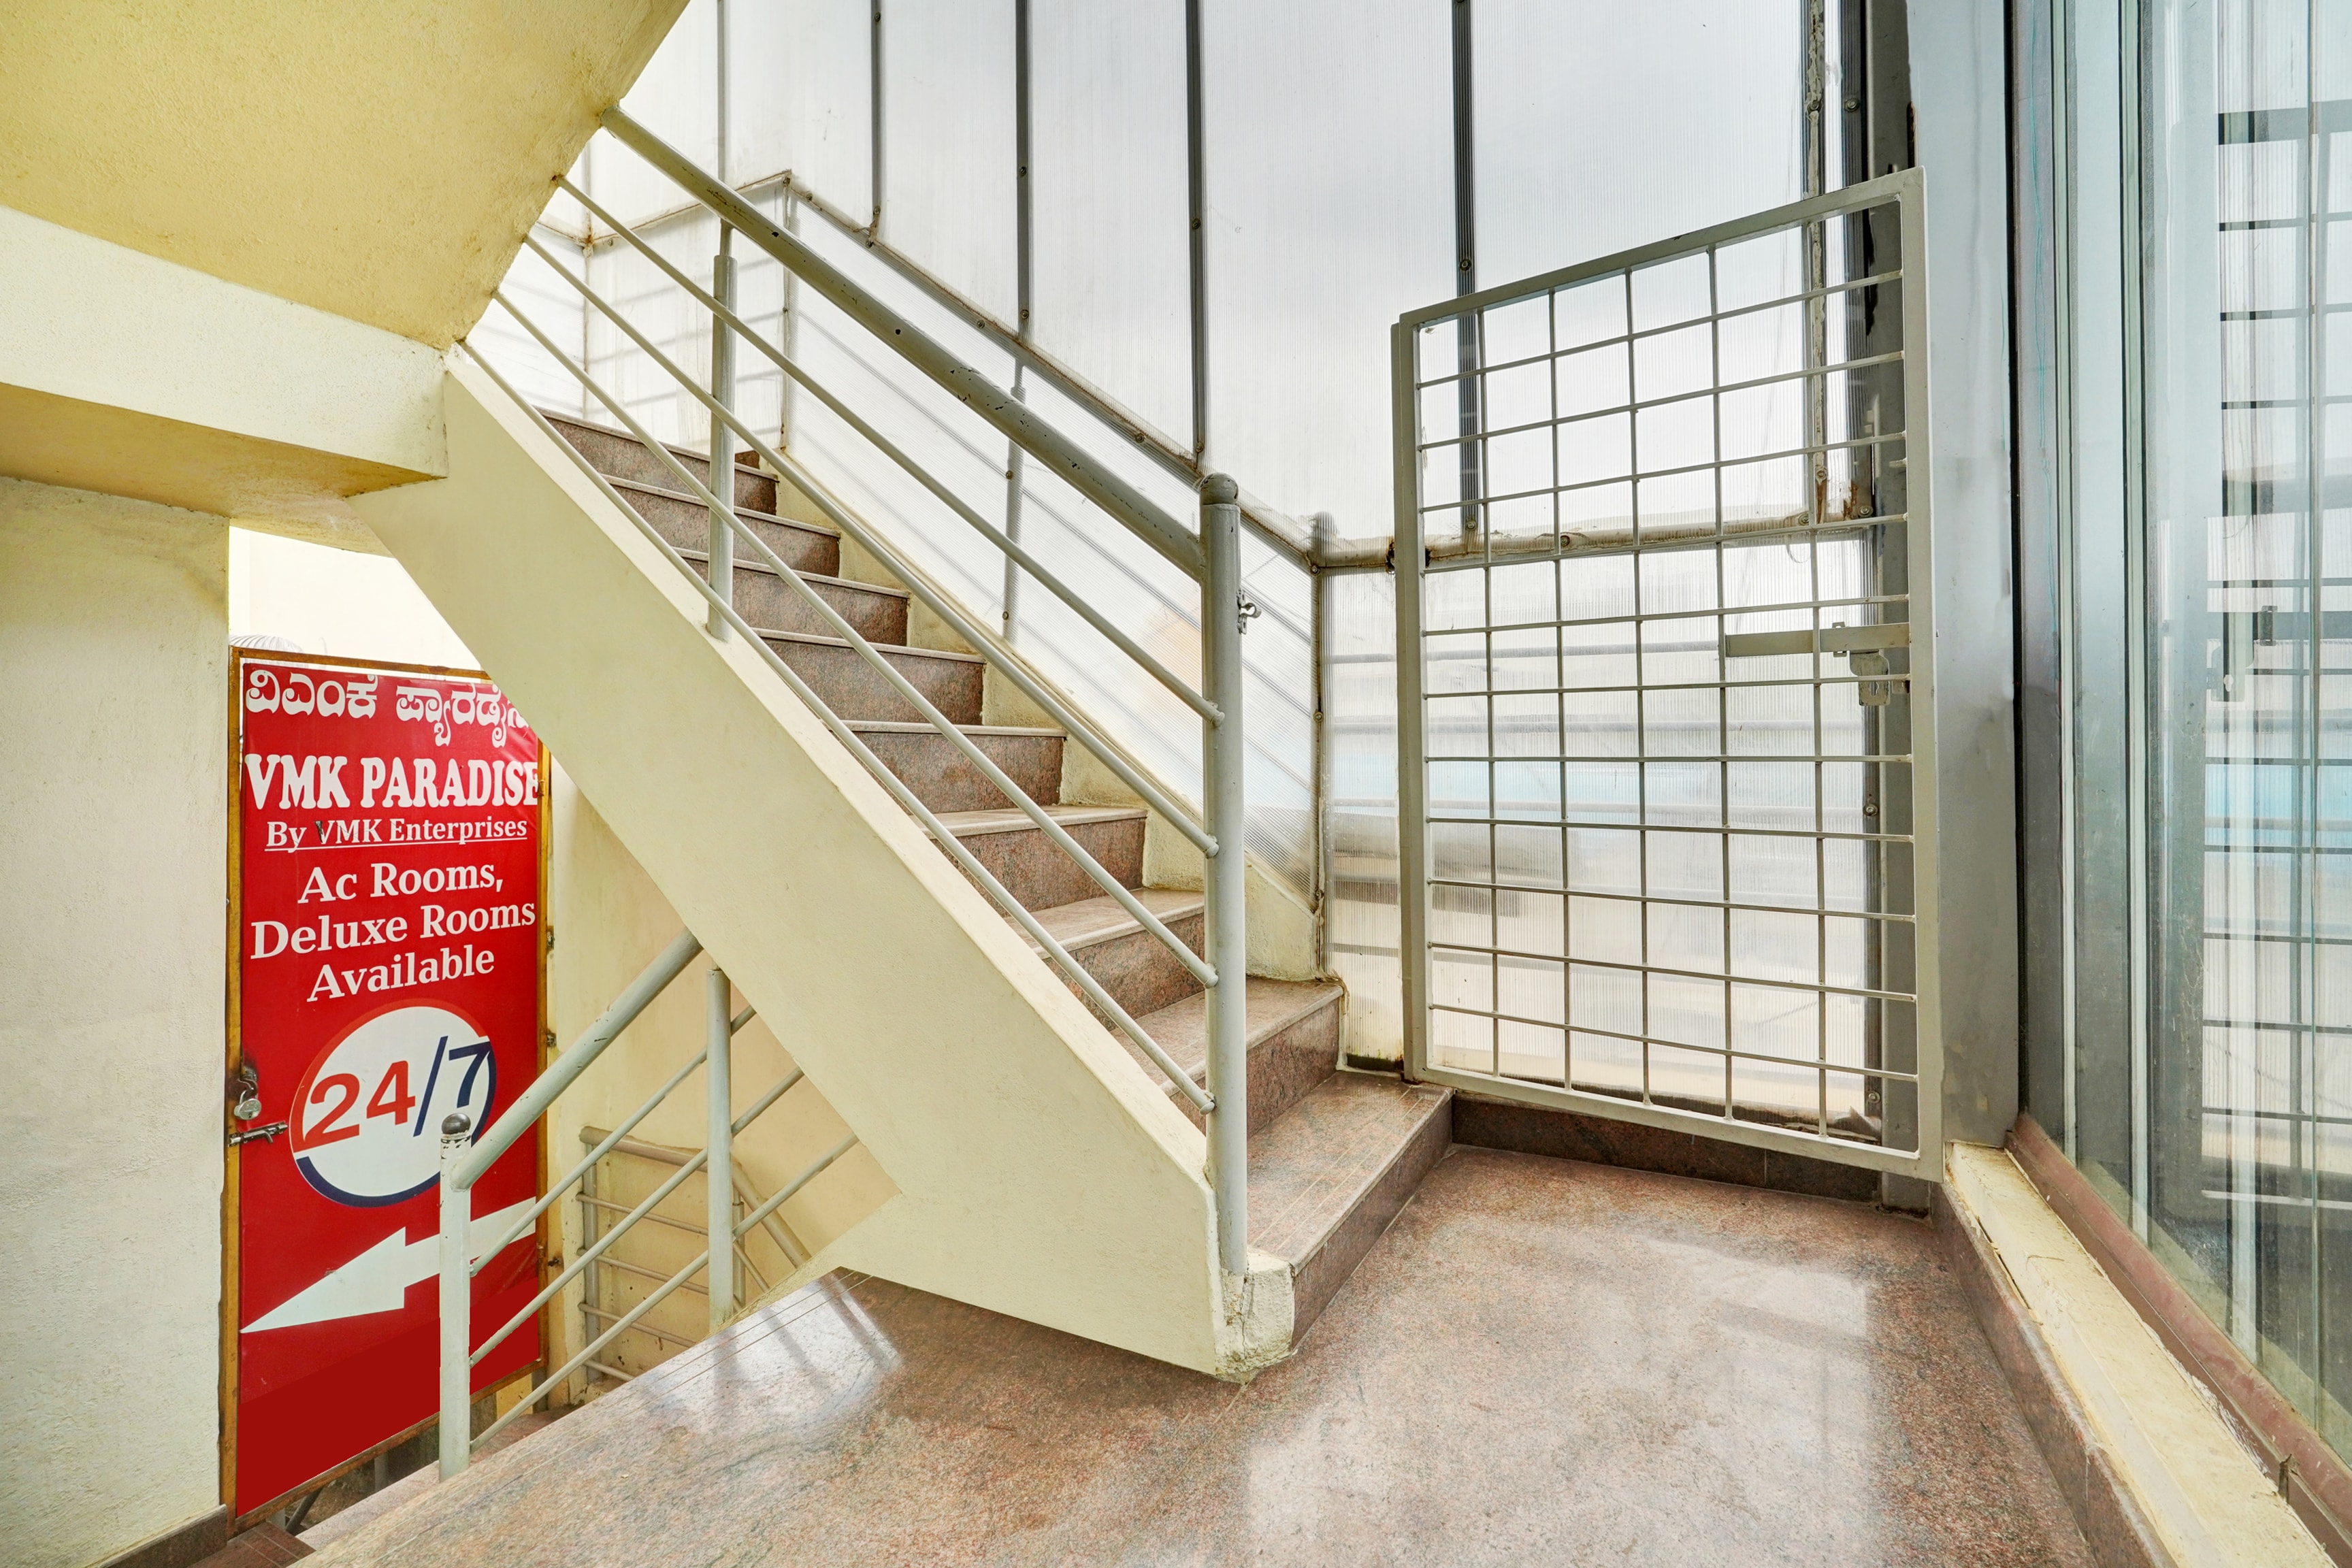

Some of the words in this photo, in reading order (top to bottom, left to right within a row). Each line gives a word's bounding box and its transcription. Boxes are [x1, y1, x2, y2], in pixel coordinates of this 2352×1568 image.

[244, 753, 350, 810] VMK
[360, 756, 538, 808] PARADISE
[266, 821, 306, 853] By
[315, 819, 382, 845] VMK
[389, 816, 527, 845] Enterprises
[297, 867, 357, 904] Ac
[370, 863, 503, 898] Rooms,
[250, 915, 408, 960] Deluxe
[420, 902, 536, 938] Rooms
[306, 945, 494, 1002] Available
[303, 1035, 491, 1150] 24/7
